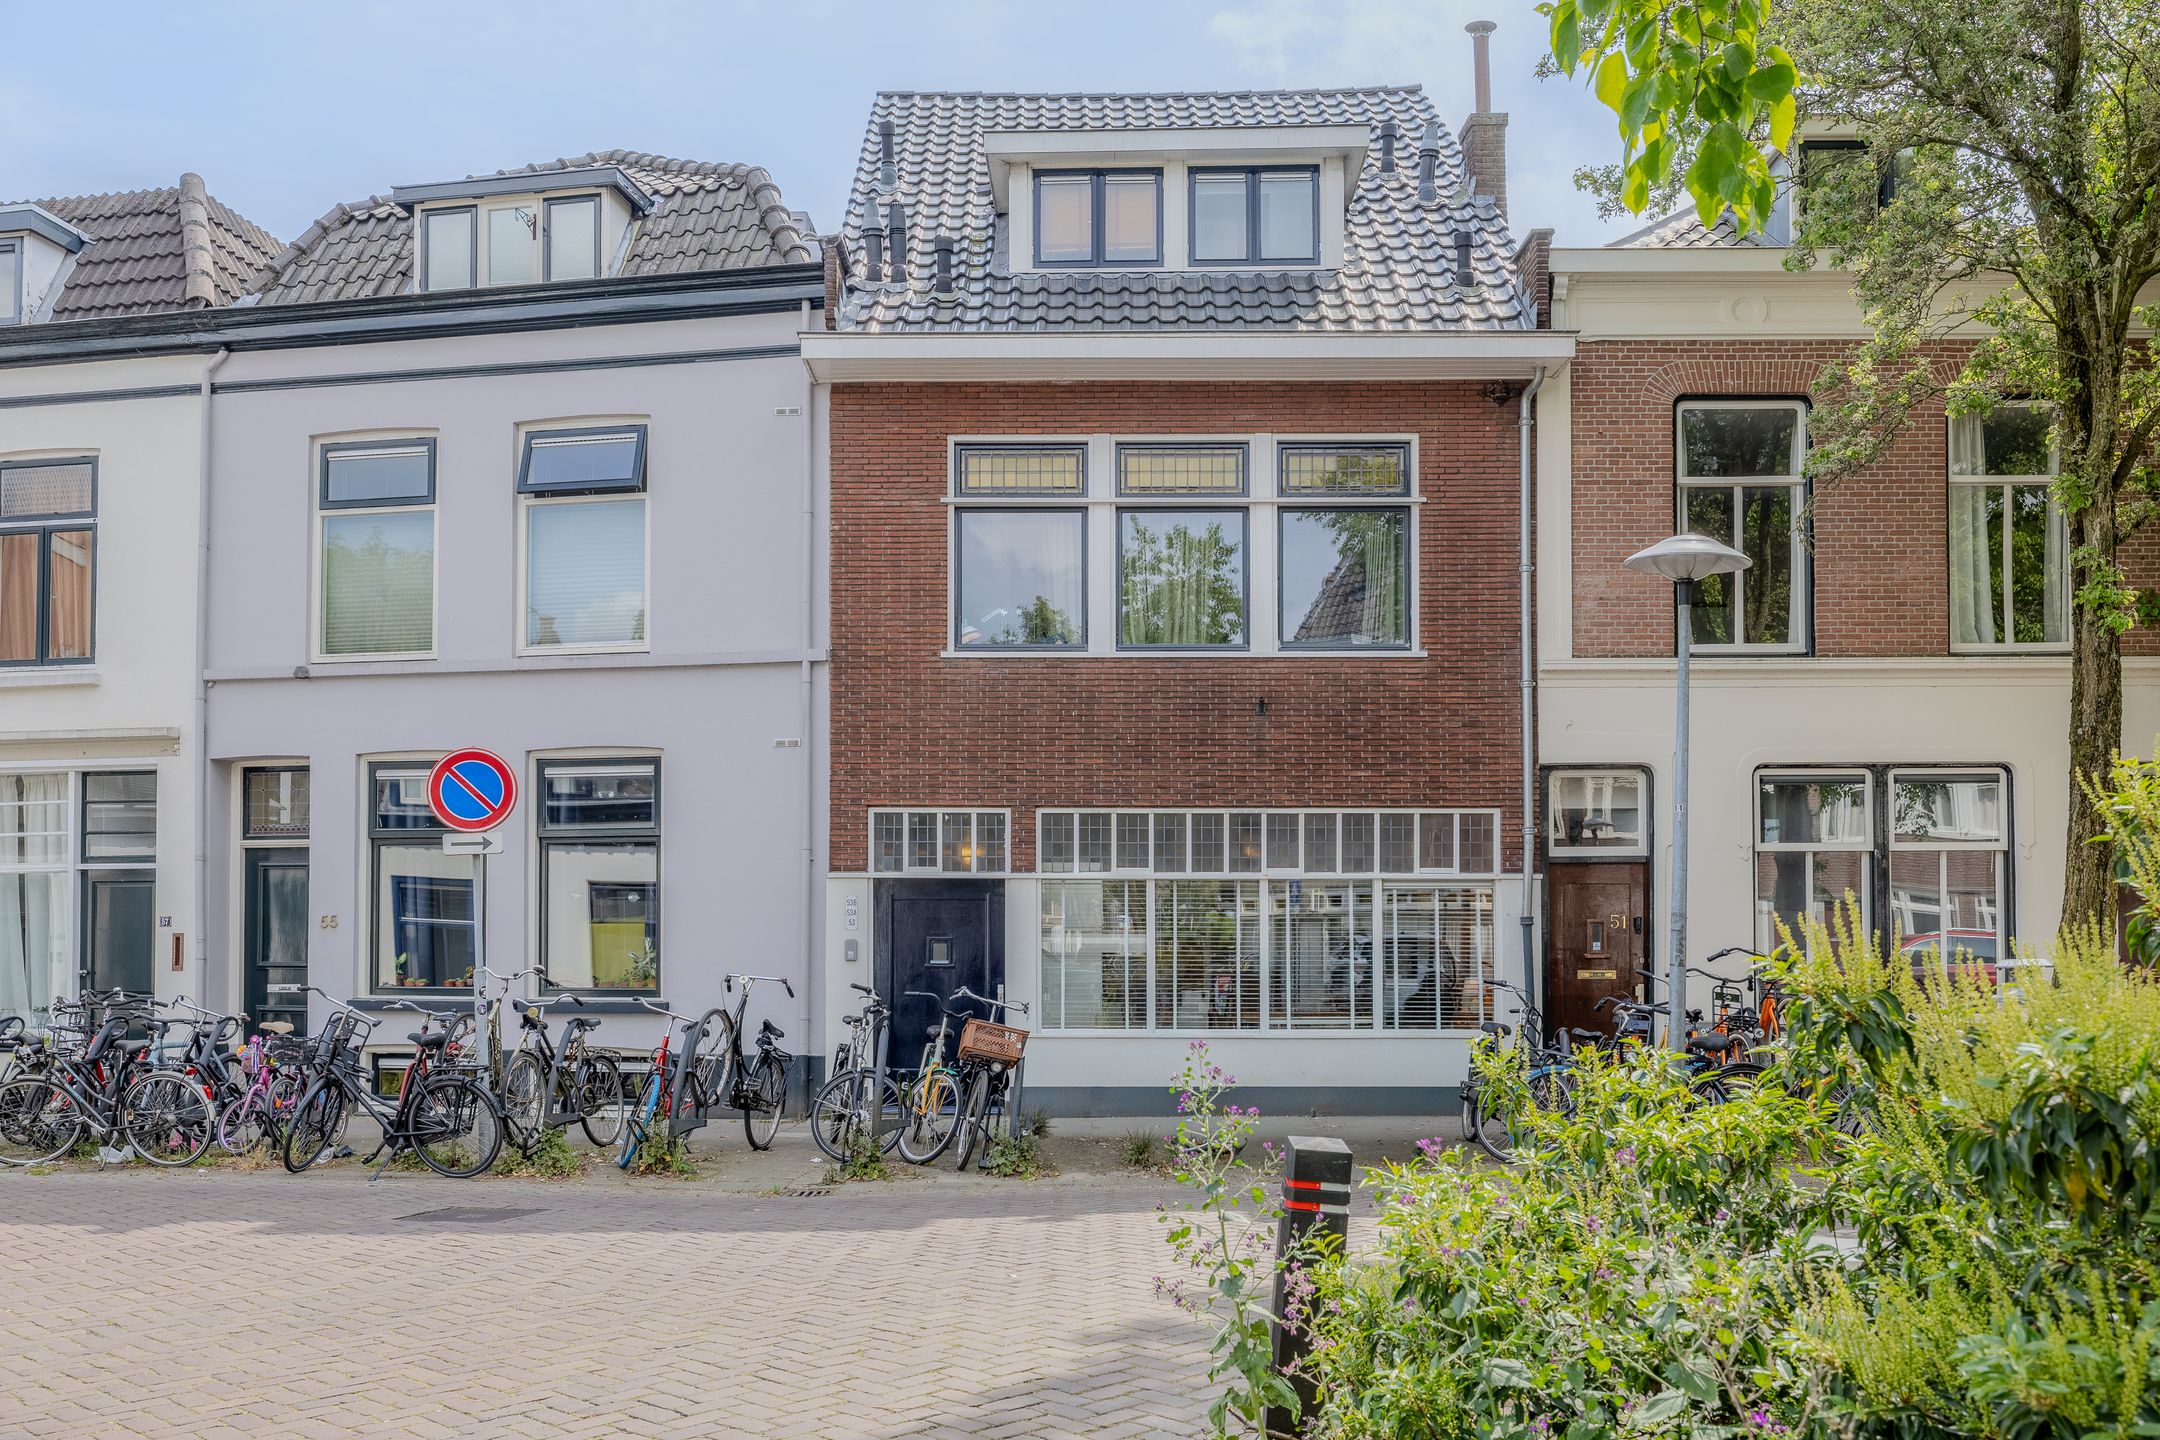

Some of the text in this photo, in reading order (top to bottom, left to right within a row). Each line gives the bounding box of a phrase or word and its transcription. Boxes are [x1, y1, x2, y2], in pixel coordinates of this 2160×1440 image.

[161, 917, 169, 926] 57
[320, 915, 338, 929] 55
[1610, 914, 1626, 929] 51
